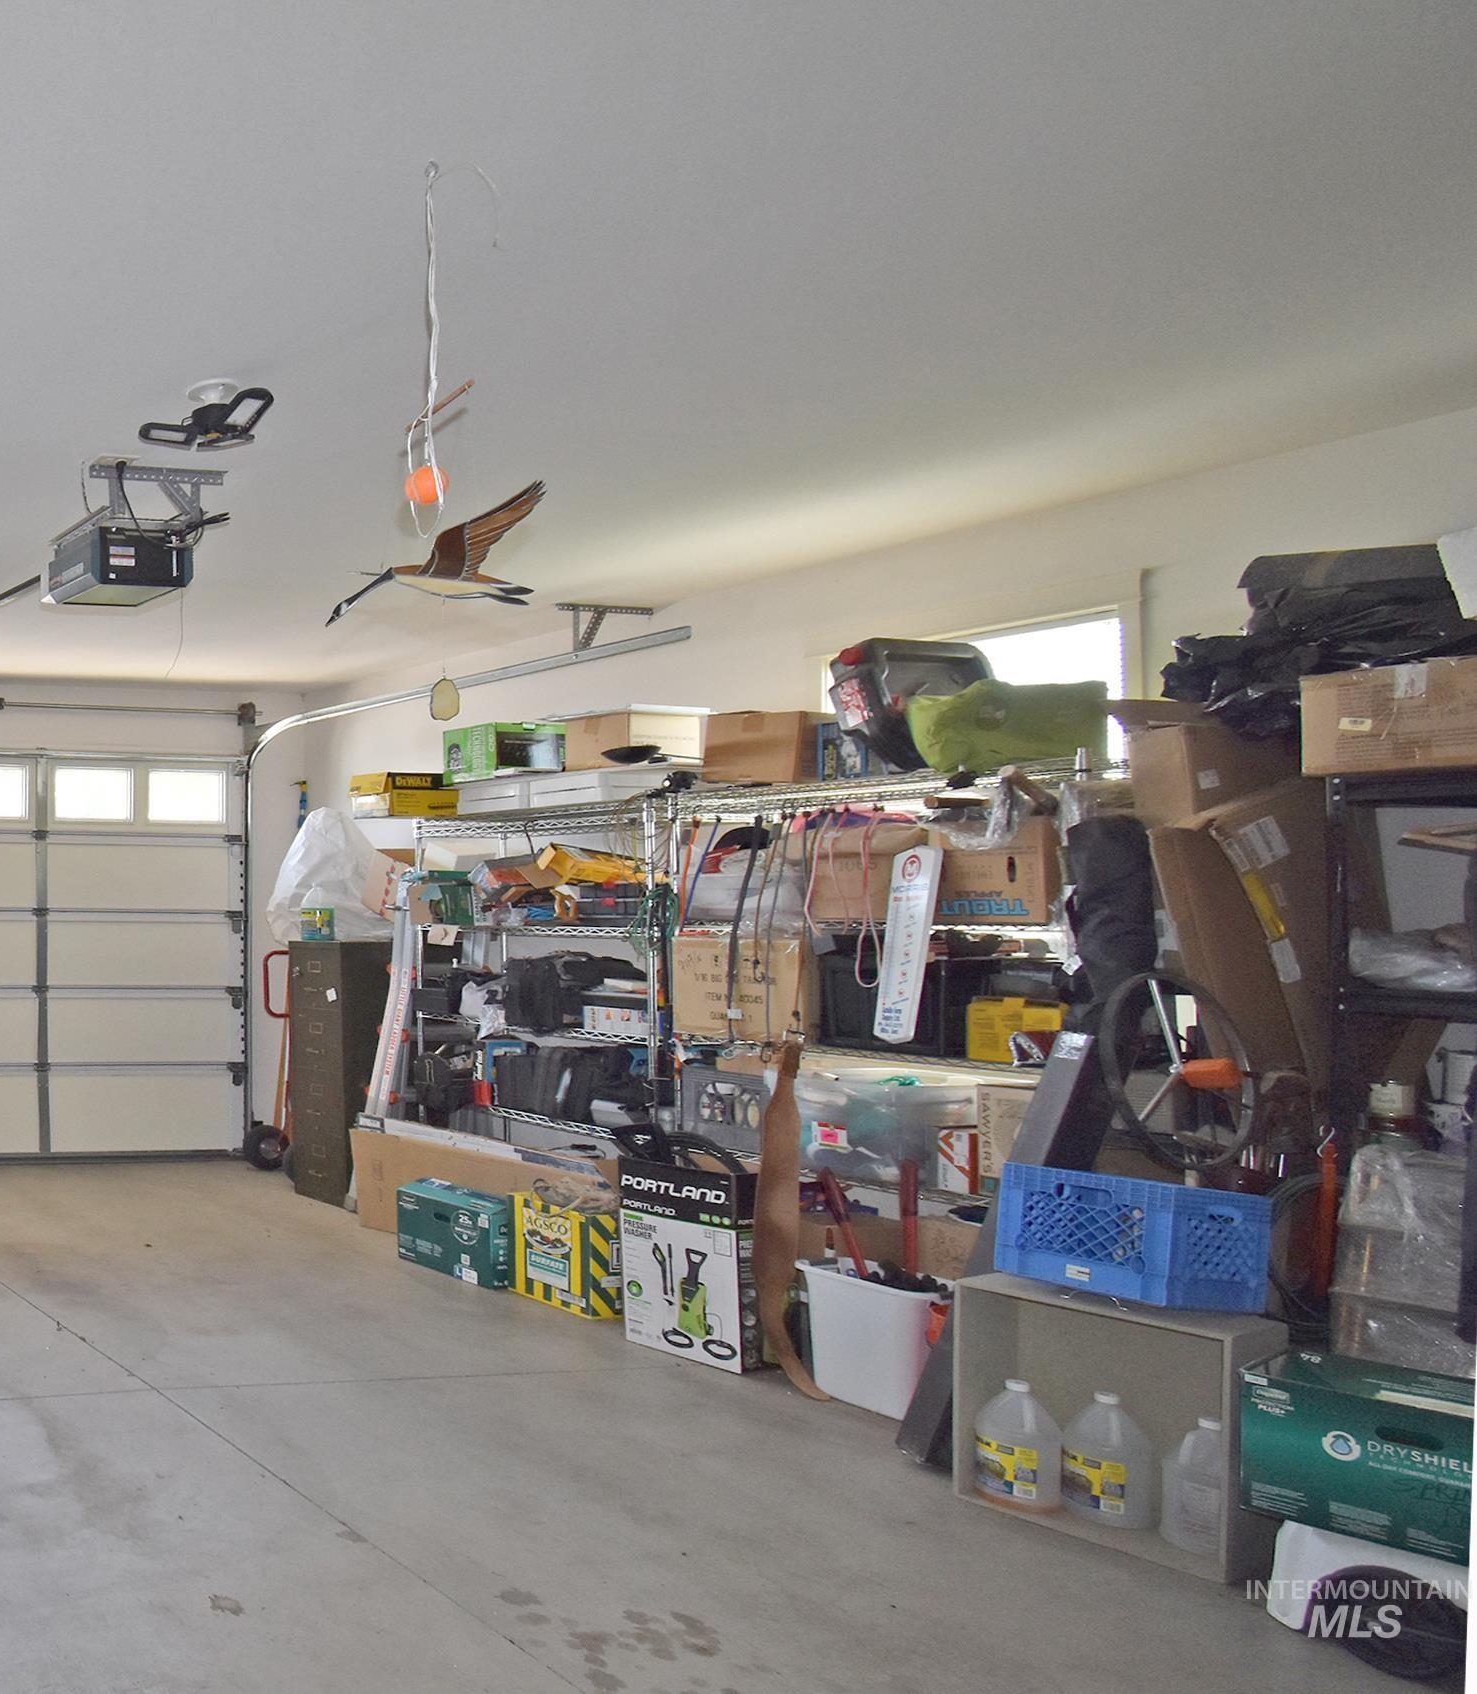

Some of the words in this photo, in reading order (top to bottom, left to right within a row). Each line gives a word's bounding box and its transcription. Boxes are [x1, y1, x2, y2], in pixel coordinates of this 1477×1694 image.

[939, 899, 1030, 917] TROUT
[982, 1092, 994, 1174] SAWYER'S
[620, 1174, 727, 1205] PORTLAND
[622, 1198, 676, 1216] PORTLAND
[524, 1216, 568, 1236] AGSCO
[623, 1218, 658, 1234] PRESSURE
[623, 1228, 653, 1240] WASHER
[1367, 1440, 1473, 1474] DRYSHIEL
